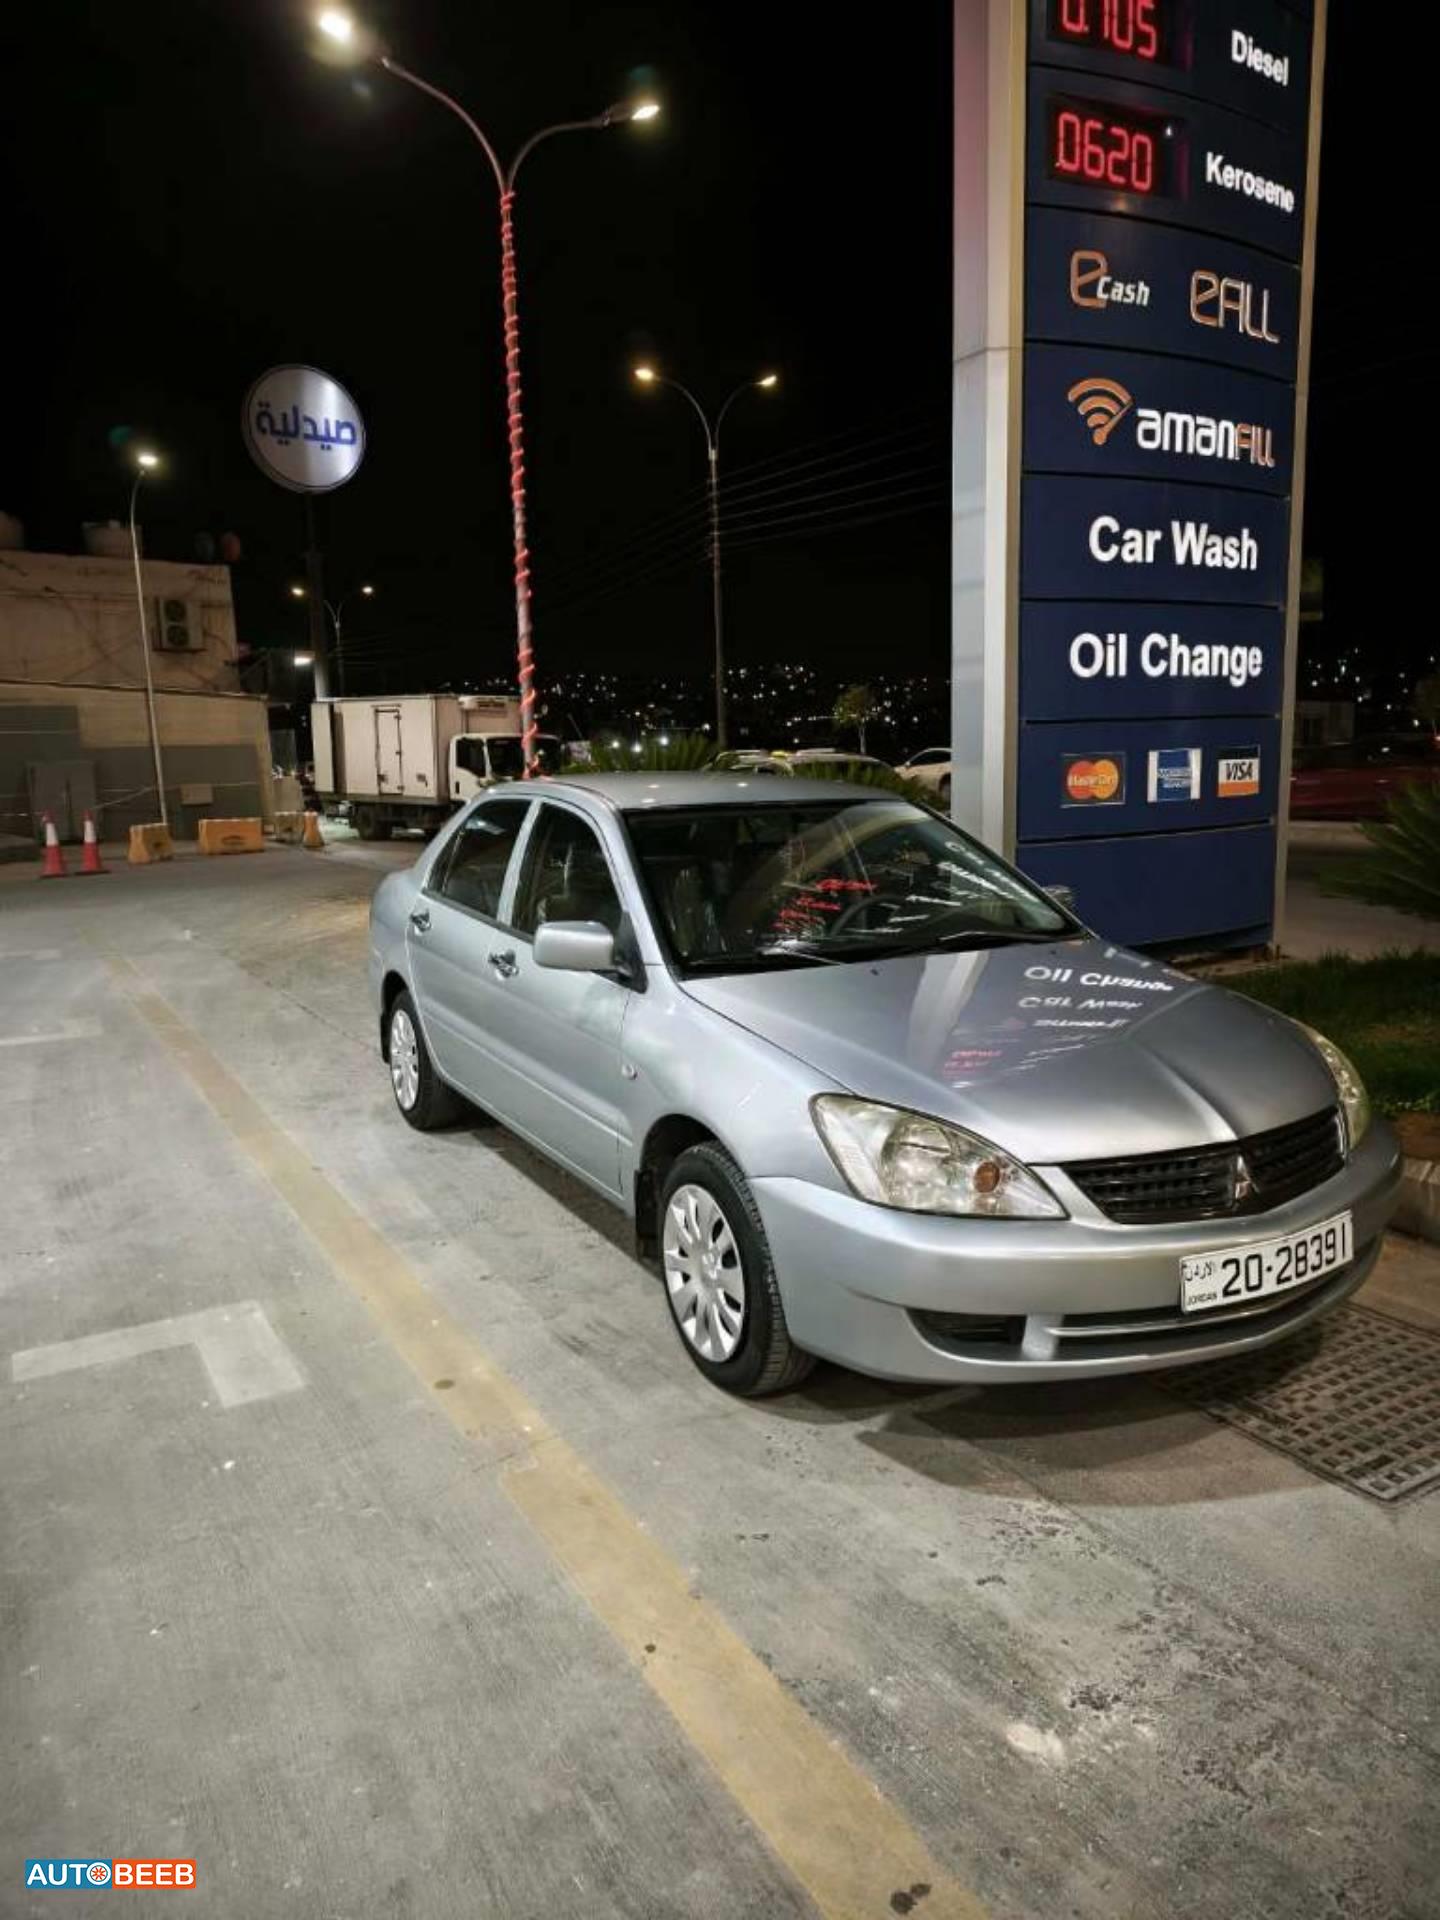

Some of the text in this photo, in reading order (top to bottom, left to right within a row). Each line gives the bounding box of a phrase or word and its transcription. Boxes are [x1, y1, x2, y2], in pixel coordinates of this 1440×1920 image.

[1231, 29, 1289, 86] Diesel
[1205, 151, 1295, 213] Kerosene
[256, 400, 357, 451] صيدلية
[1089, 515, 1258, 571] Car Wash
[1069, 632, 1264, 688] Oil Change
[1225, 762, 1254, 781] VISA
